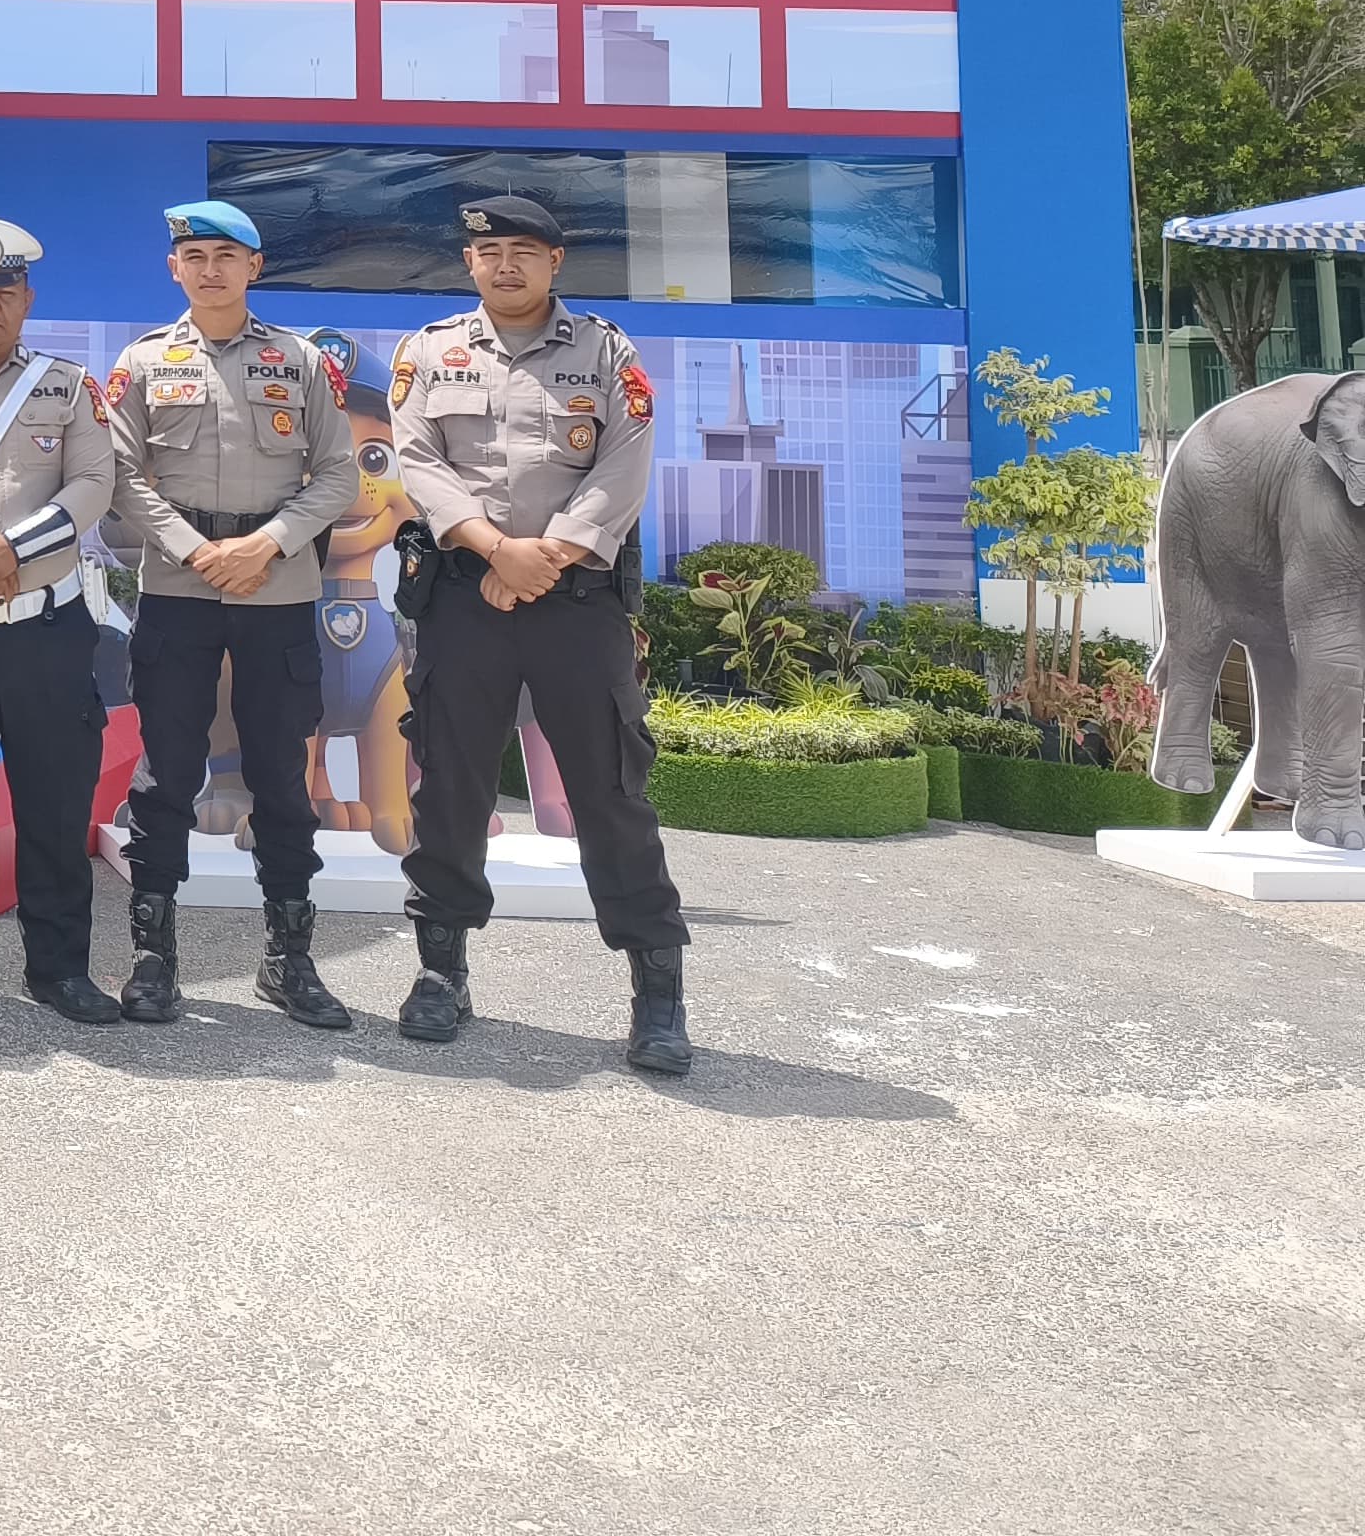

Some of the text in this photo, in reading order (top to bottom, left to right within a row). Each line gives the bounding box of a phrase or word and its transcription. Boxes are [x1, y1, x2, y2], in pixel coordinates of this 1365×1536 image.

[248, 365, 300, 381] POLRI
[430, 370, 481, 383] ALEN
[554, 372, 602, 390] POLRI
[30, 386, 68, 399] OLRI
